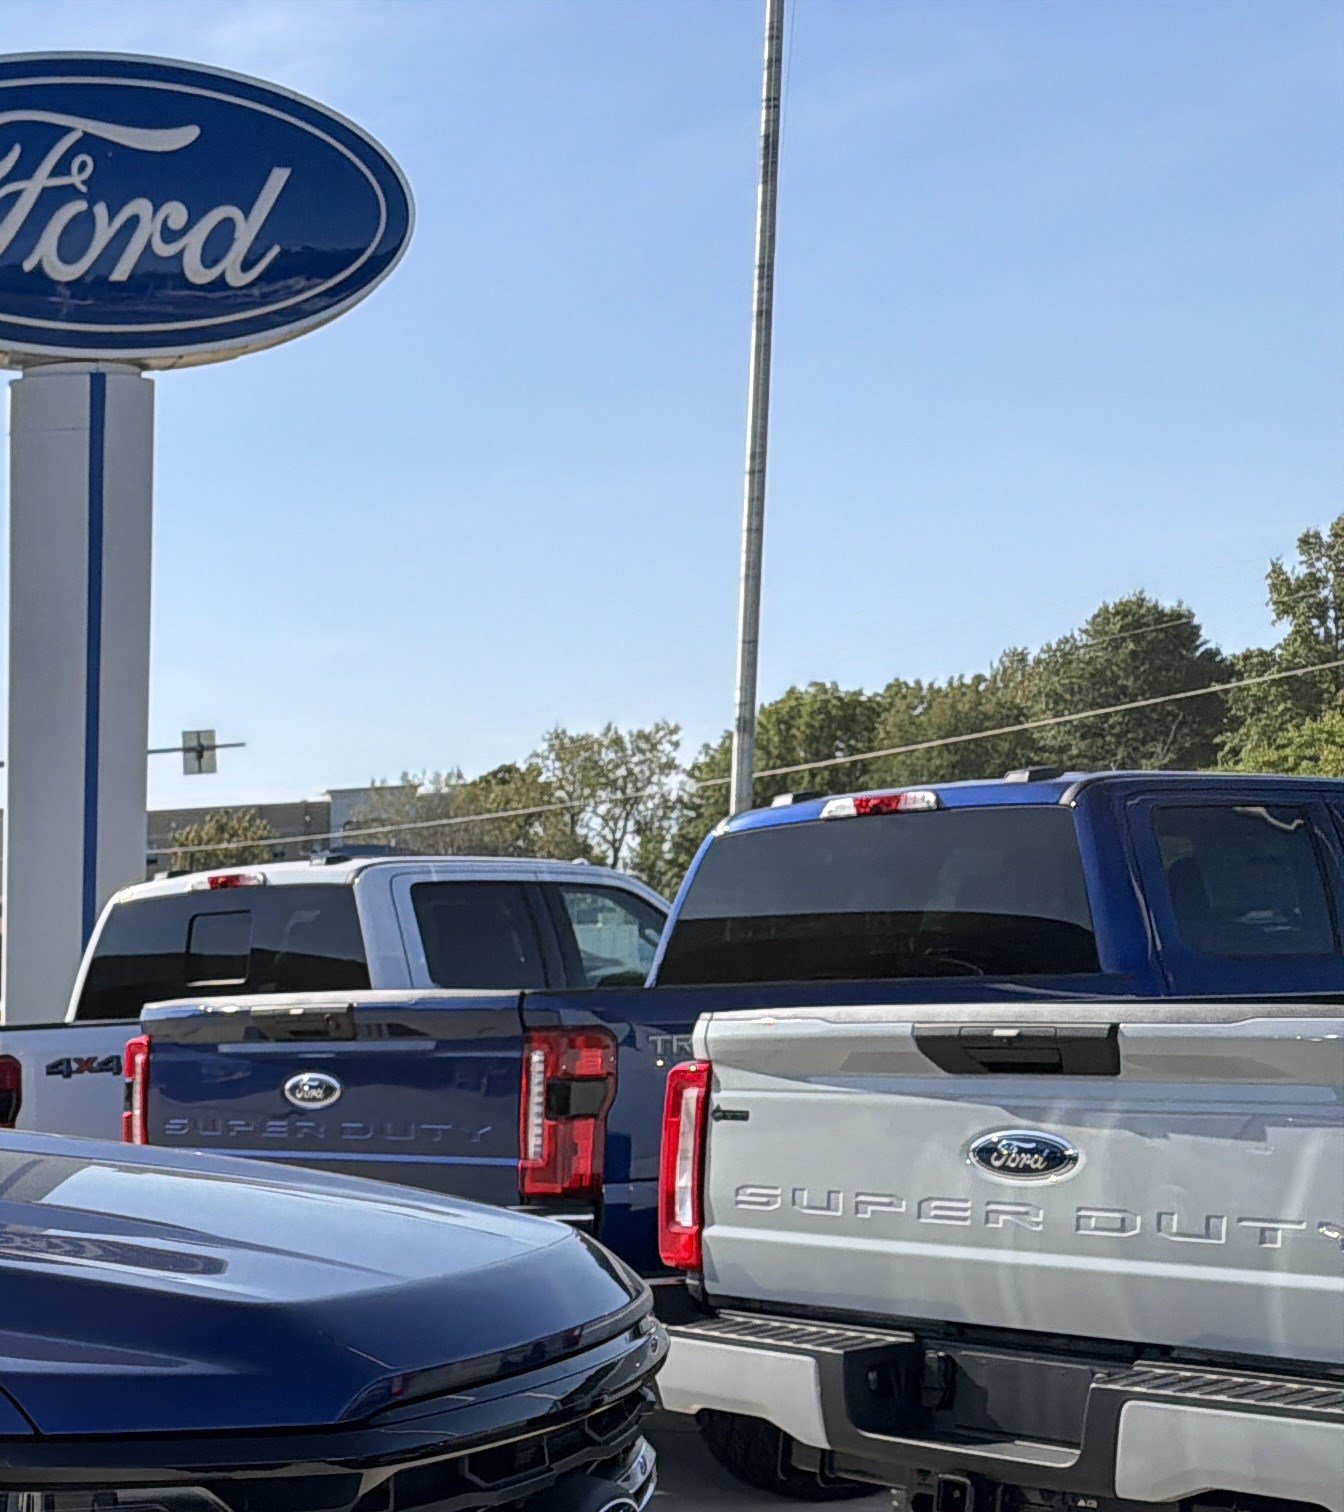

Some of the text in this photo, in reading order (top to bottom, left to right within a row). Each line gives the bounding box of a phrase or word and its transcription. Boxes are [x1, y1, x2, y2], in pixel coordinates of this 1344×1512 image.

[295, 1075, 325, 1100] Ford
[165, 1117, 492, 1143] SUPER DUTY
[990, 1139, 1051, 1170] Ford
[734, 1183, 1044, 1231] SUPER
